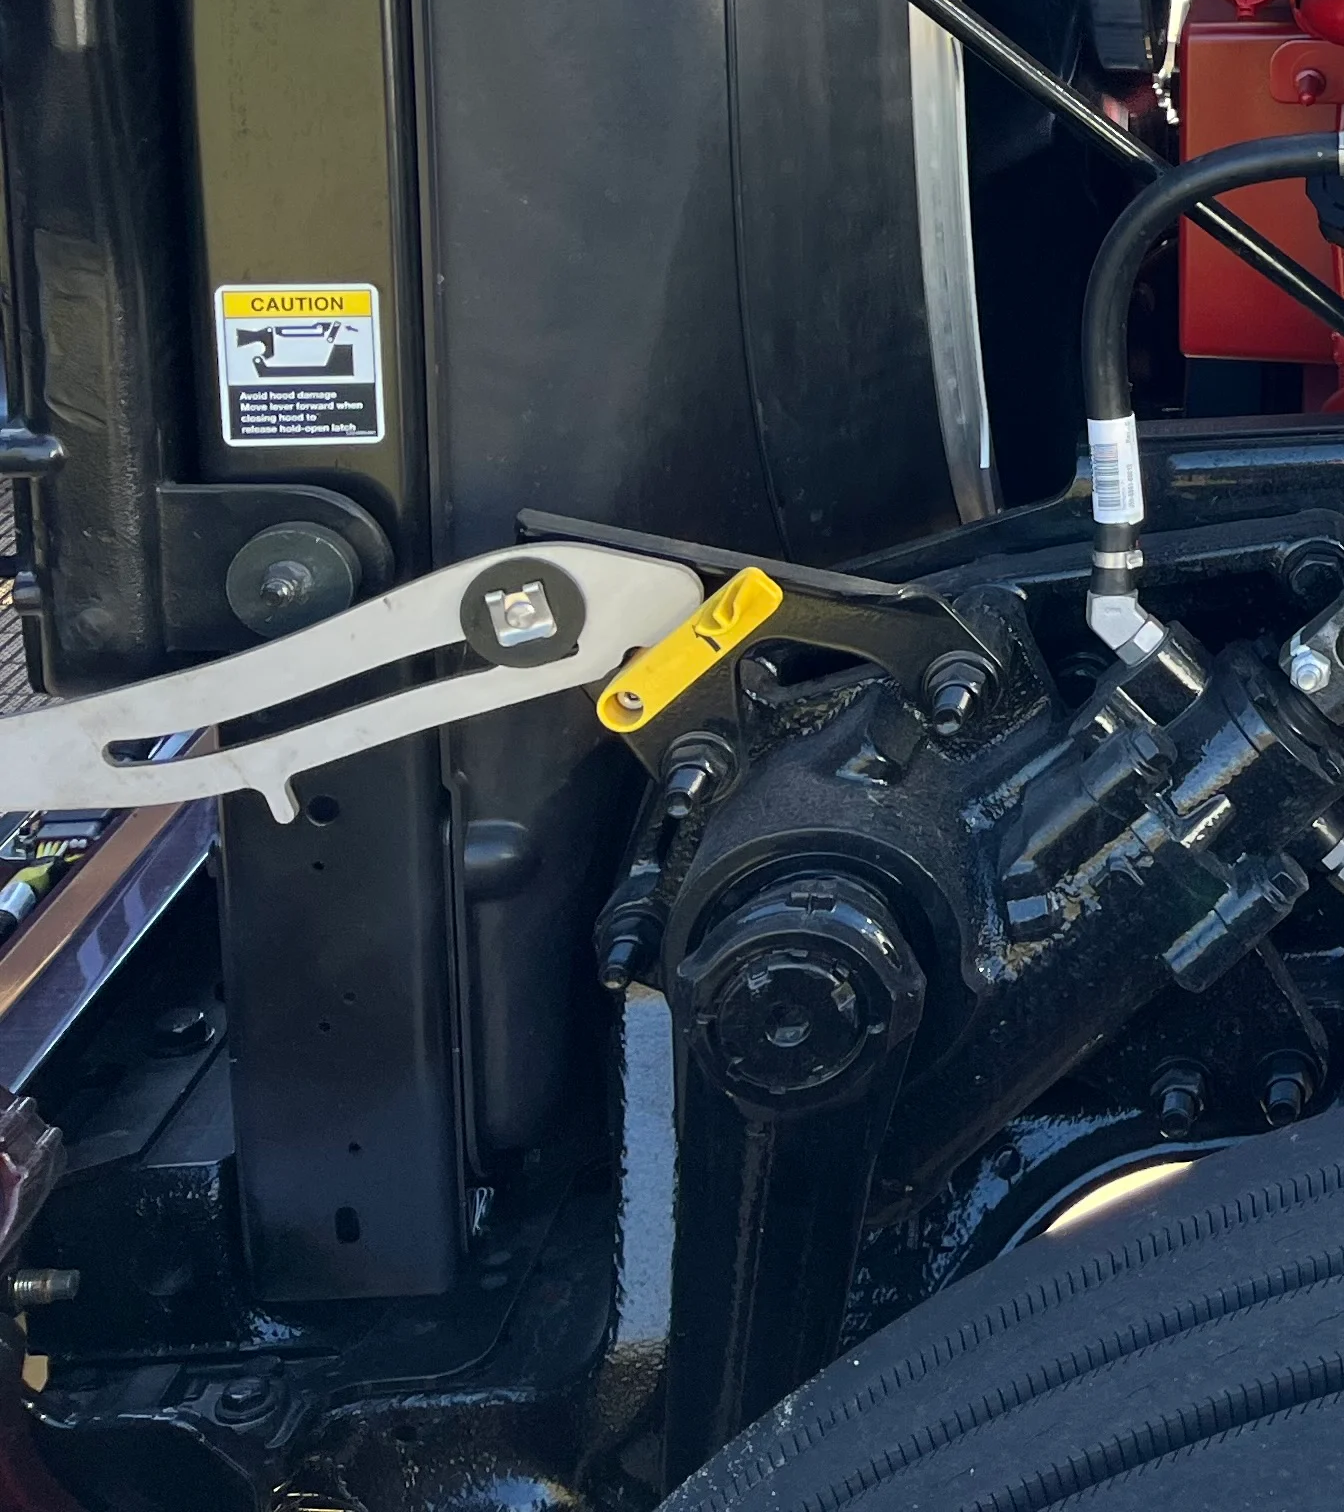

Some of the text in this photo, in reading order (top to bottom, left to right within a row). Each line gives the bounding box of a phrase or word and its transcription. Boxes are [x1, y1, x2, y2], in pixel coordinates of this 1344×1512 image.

[251, 296, 344, 312] CAUTION
[239, 390, 337, 400] Avoid hood damage
[240, 401, 363, 411] Move lever forward when
[240, 413, 317, 423] closing hood to
[241, 423, 356, 434] release hold-open latch
